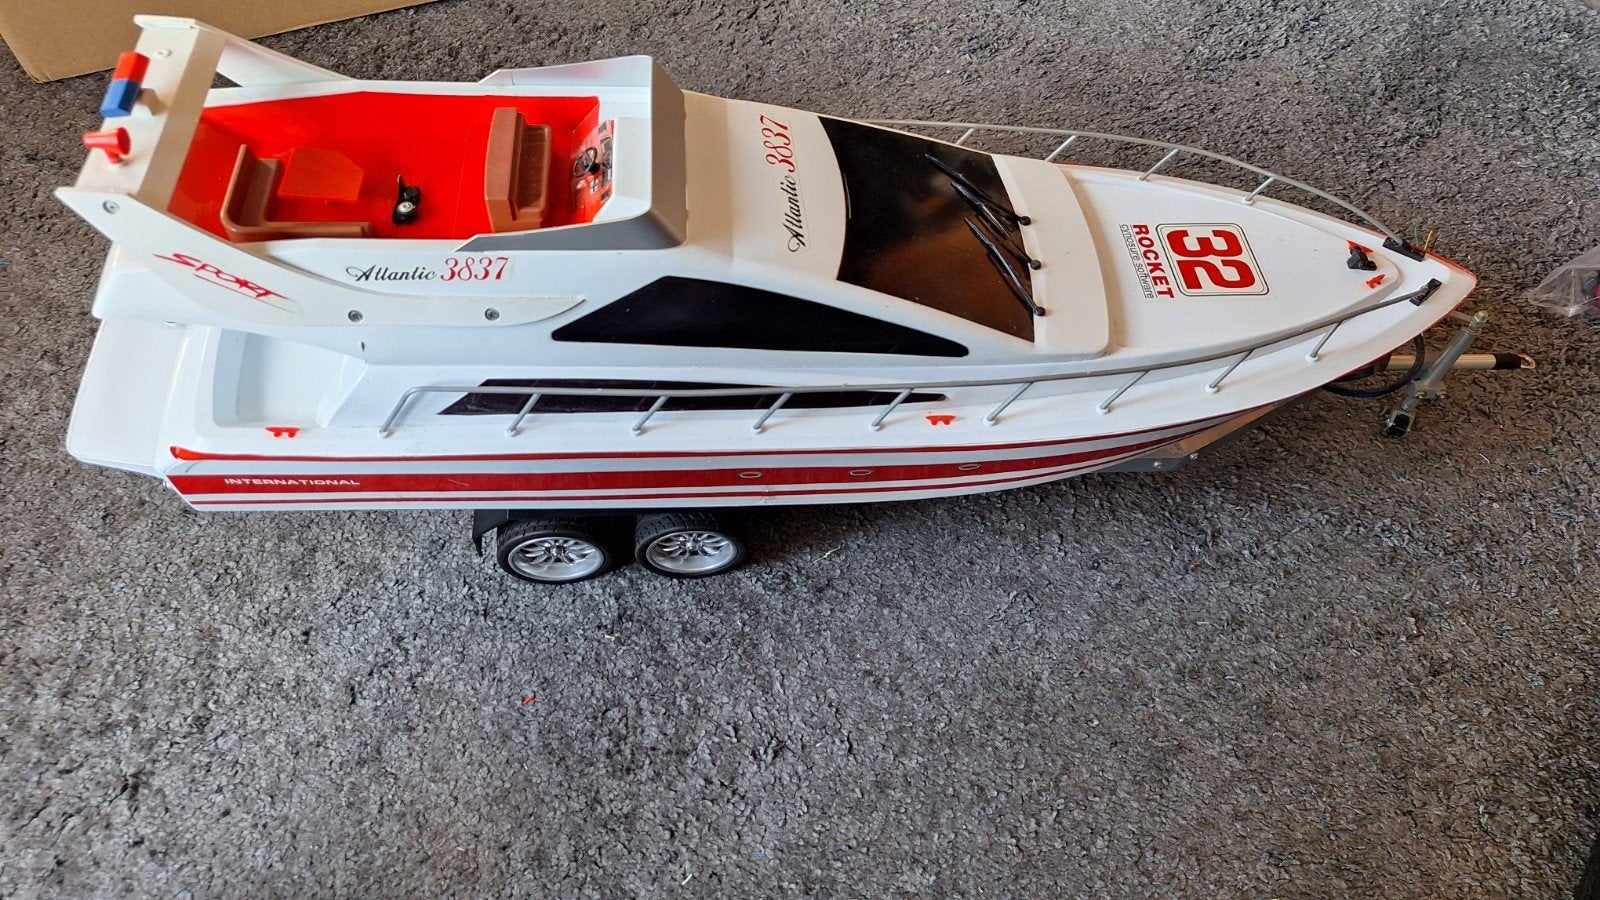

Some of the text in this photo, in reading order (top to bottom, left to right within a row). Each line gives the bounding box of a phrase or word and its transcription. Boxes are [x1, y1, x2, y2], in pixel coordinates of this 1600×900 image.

[759, 115, 806, 253] Atlantic 3837
[153, 253, 297, 302] SPORT
[345, 256, 509, 282] Atlantic 3837
[1121, 224, 1155, 299] cynosure software
[1132, 224, 1175, 299] ROCKET
[1166, 229, 1256, 290] 32
[224, 478, 361, 486] INTERNATIONAL
